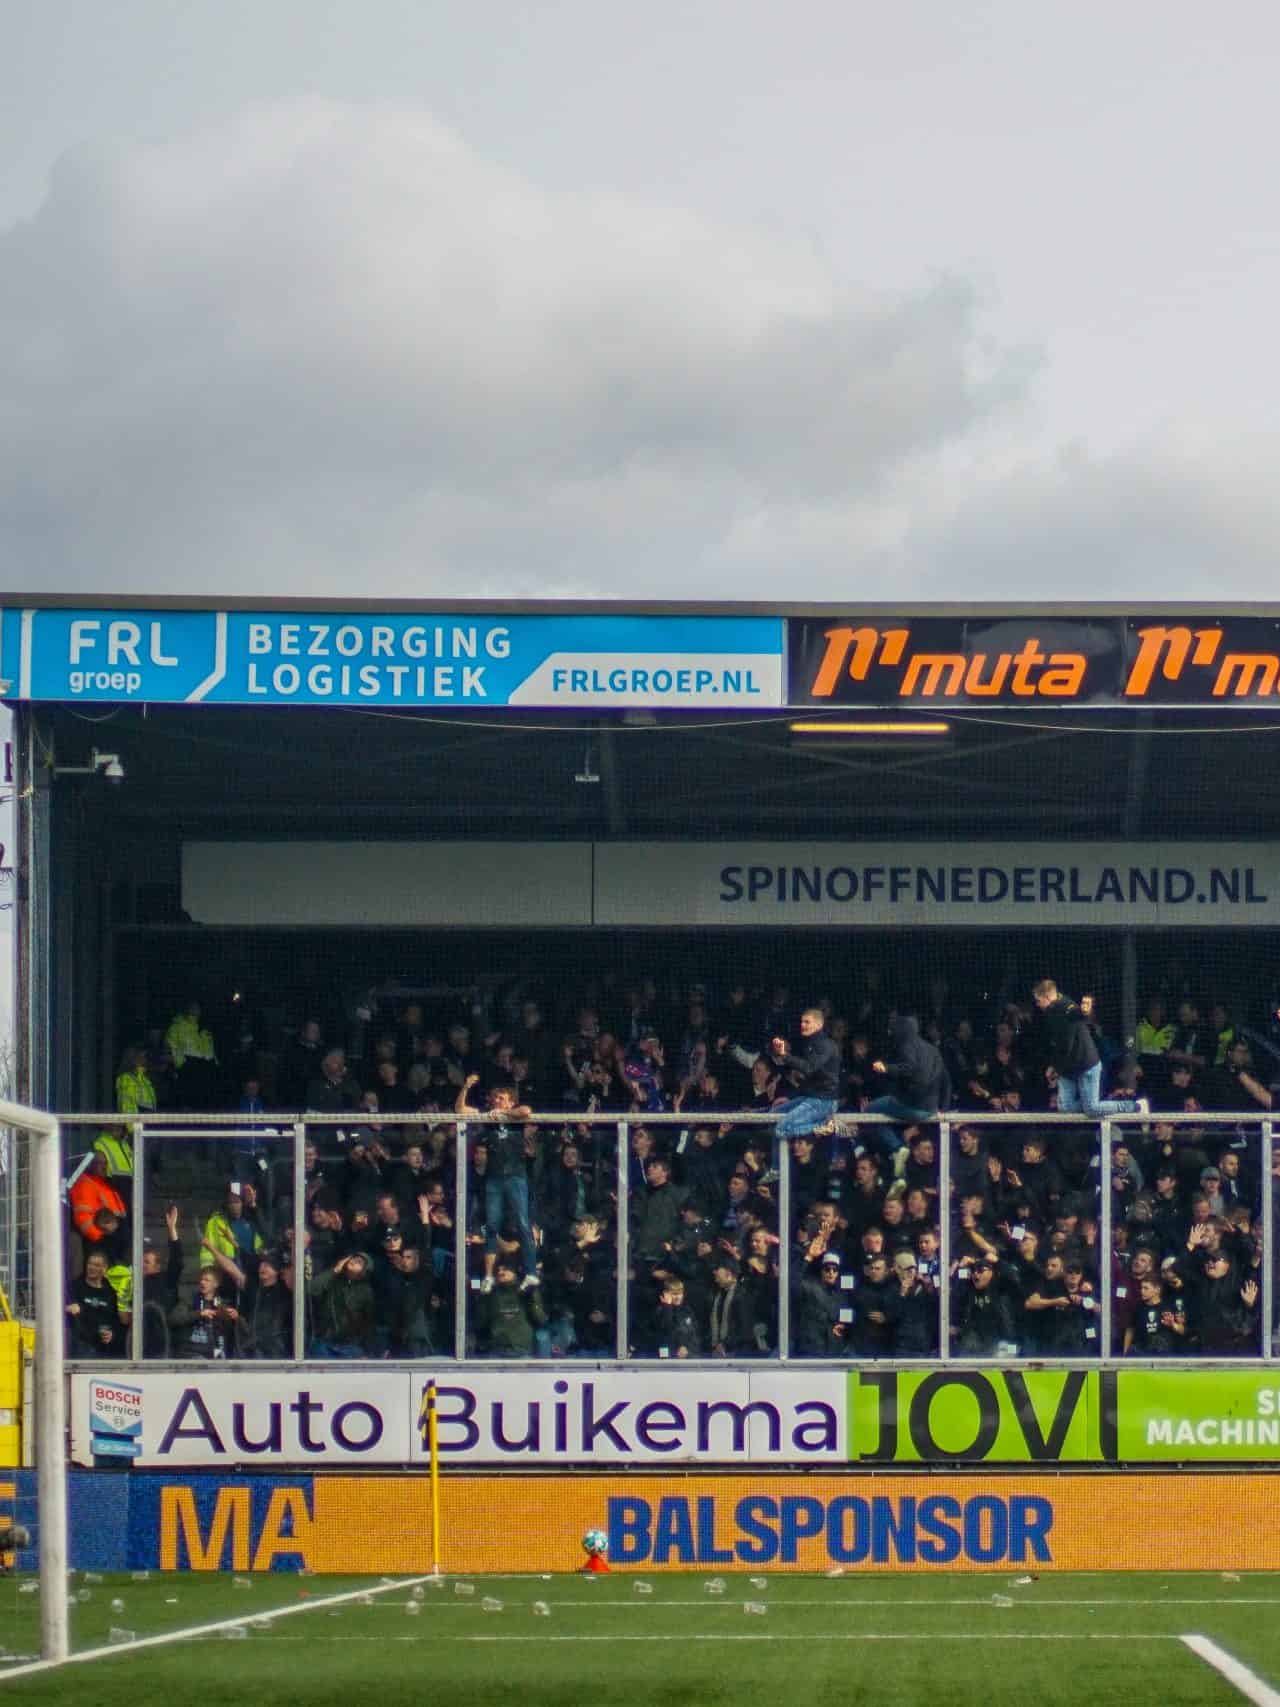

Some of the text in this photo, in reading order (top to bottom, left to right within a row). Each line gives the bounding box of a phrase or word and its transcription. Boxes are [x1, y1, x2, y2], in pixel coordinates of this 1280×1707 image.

[69, 620, 178, 667] FRL
[248, 623, 512, 659] BEZORGING
[69, 671, 141, 694] groep
[247, 663, 488, 698] LOGISTIEK
[552, 668, 761, 694] FRLGROEP.NL
[900, 639, 1087, 696] muta
[719, 865, 1268, 904] SPINOFFNEDERLAND.NL
[95, 1387, 141, 1406] BOSCH
[95, 1400, 141, 1417] Service
[157, 1380, 839, 1454] Auto Buikema
[606, 1495, 1054, 1563] BALSPONSOR
